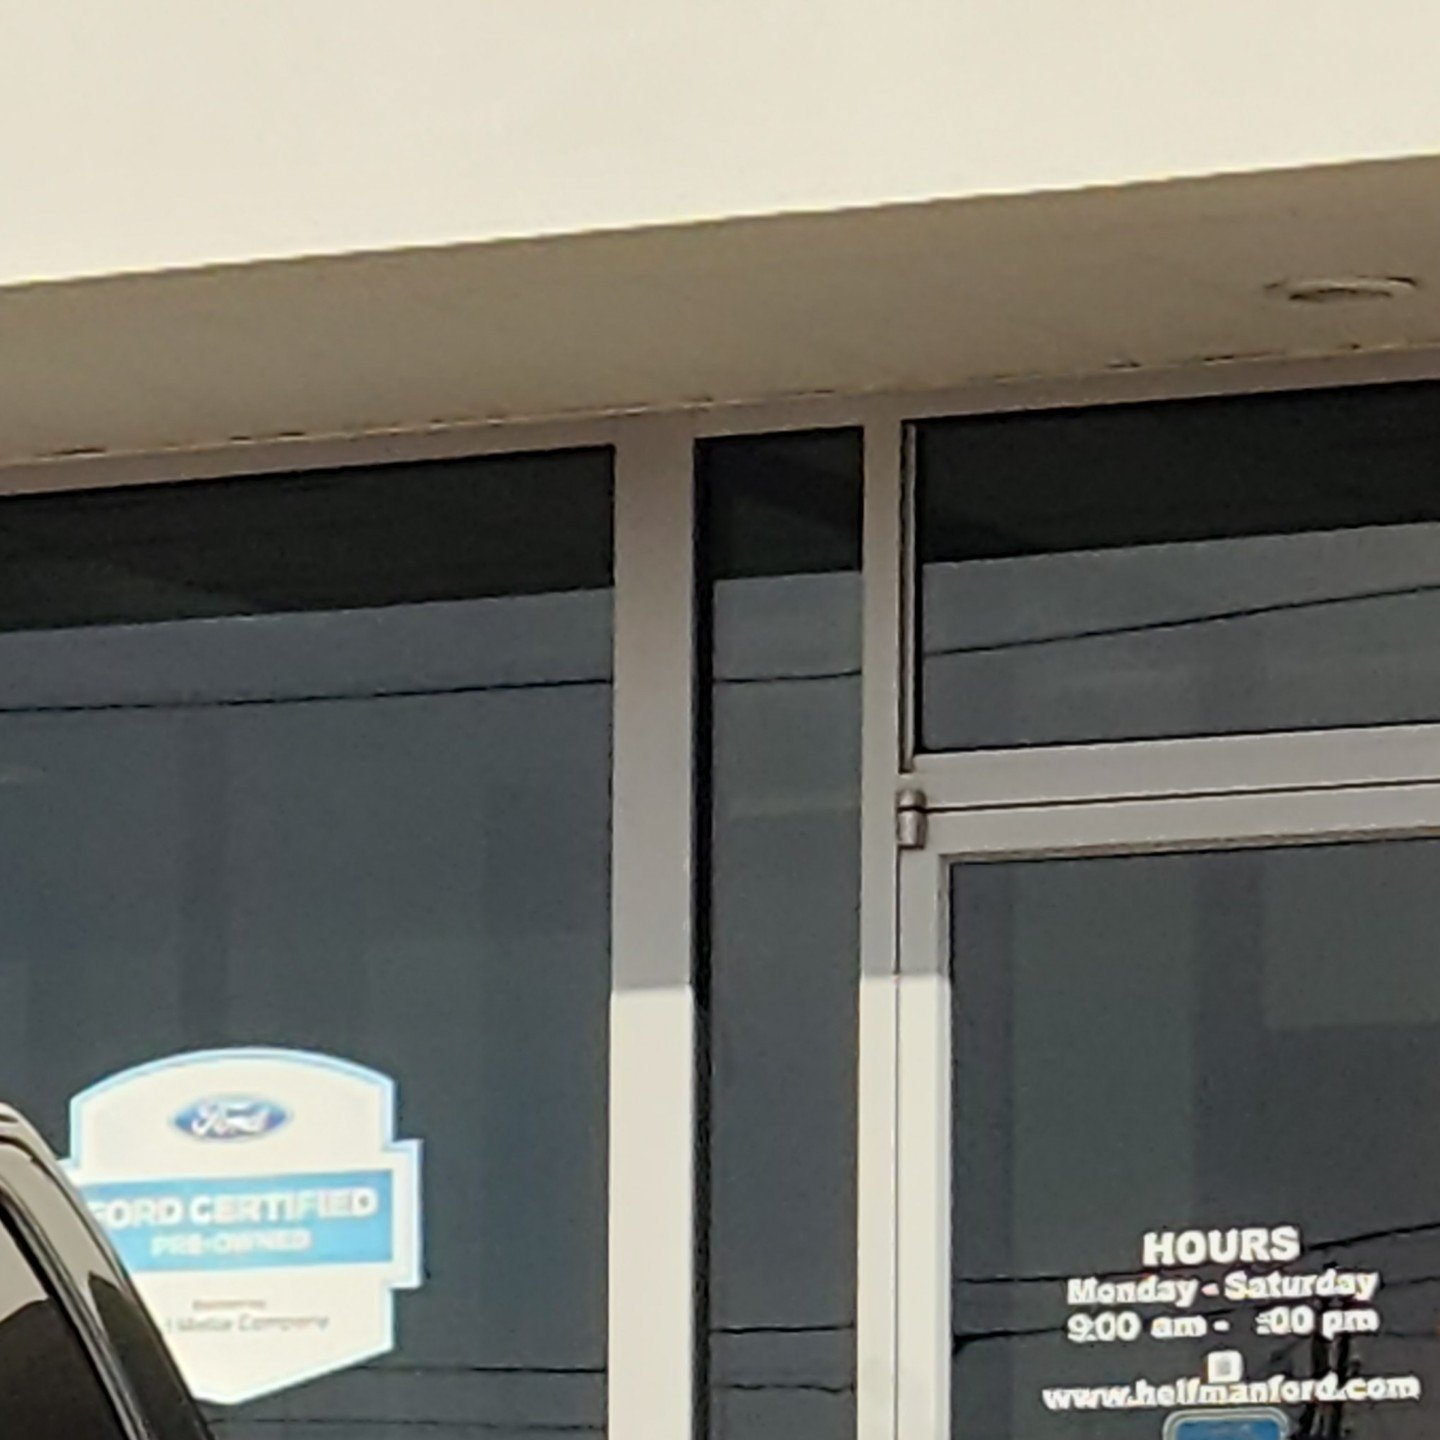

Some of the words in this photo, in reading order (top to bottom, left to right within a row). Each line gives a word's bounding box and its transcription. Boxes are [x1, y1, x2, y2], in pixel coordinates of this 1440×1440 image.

[191, 1098, 270, 1136] Ford
[189, 1186, 378, 1226] CERTIFIED
[150, 1228, 313, 1256] PRE-OWNED
[1141, 1226, 1302, 1266] HOURS
[1066, 1275, 1198, 1307] Monday
[1223, 1269, 1382, 1302] Saturday
[1066, 1310, 1142, 1343] 9:00
[1149, 1313, 1208, 1339] am
[1320, 1306, 1381, 1341] pm
[1041, 1371, 1422, 1411] www.helfmanford.com
